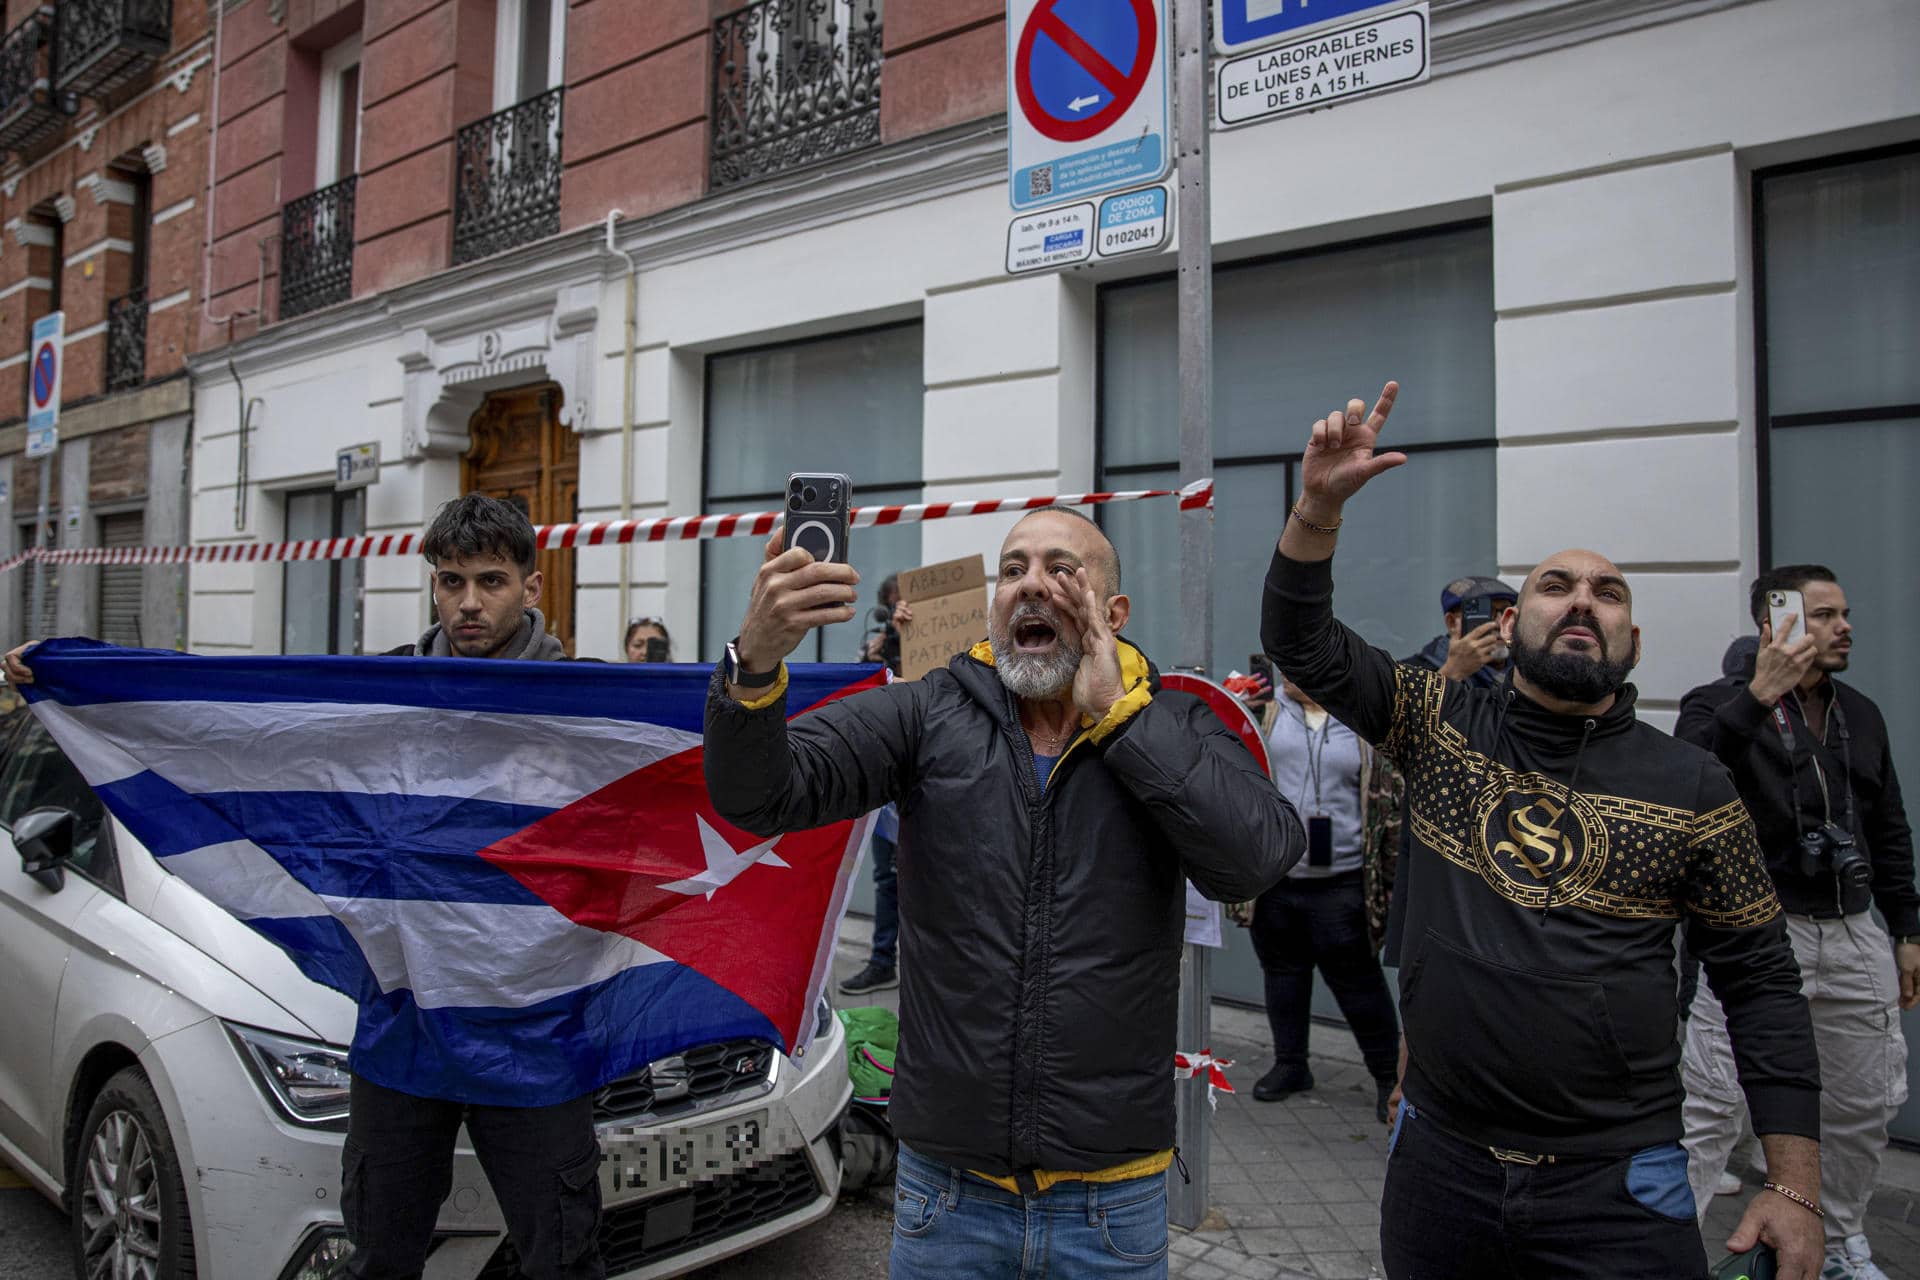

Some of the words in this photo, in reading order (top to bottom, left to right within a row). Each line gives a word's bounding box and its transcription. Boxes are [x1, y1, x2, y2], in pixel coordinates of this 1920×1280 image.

[1258, 28, 1378, 73] LABORABLES
[1227, 82, 1249, 99] DE
[1254, 66, 1311, 93] LUNES
[1316, 62, 1329, 76] A
[1334, 38, 1414, 72] VIERNES
[1267, 90, 1290, 108] DE
[1295, 87, 1304, 101] 8
[1309, 83, 1322, 97] A
[1328, 76, 1346, 93] 15
[1352, 72, 1369, 86] H.
[1108, 212, 1123, 224] DE
[1125, 205, 1156, 220] ZONA
[1106, 225, 1155, 246] 0102041
[484, 335, 494, 355] 2
